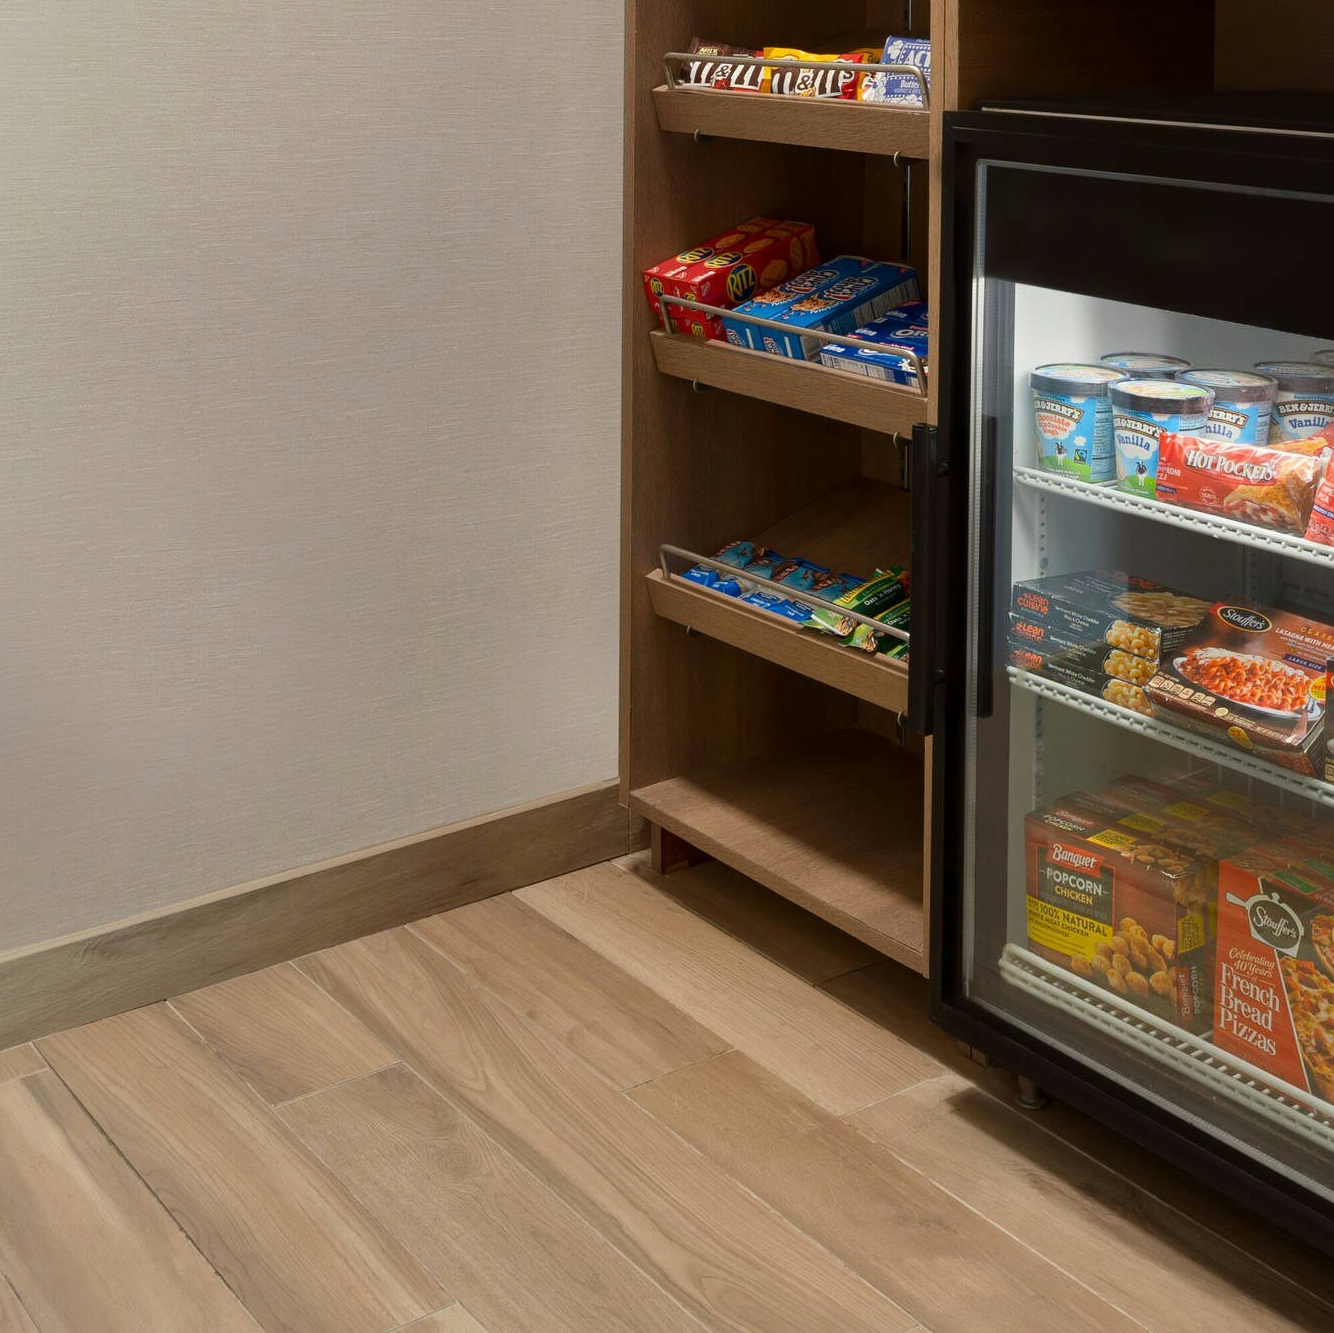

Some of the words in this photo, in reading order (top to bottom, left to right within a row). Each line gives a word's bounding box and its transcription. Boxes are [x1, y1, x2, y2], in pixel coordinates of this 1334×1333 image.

[727, 266, 757, 298] RITZ
[1186, 449, 1215, 470] HOT
[1216, 456, 1276, 482] POCKETS
[1222, 608, 1266, 631] Stouffer's
[1275, 627, 1304, 642] LASAGNA
[1304, 635, 1322, 648] WITH
[1052, 843, 1097, 870] Banquet
[1046, 867, 1103, 897] POPCORN
[1054, 885, 1093, 907] CHICKEN
[1039, 901, 1061, 921] 100%
[1062, 912, 1108, 938] NATURAL
[1252, 906, 1298, 939] Stouffer's
[1228, 947, 1275, 971] Celebrating
[1247, 963, 1274, 981] Years
[1220, 962, 1281, 1013] French
[1220, 984, 1273, 1032] Bread
[1219, 1006, 1277, 1056] Pizzas
